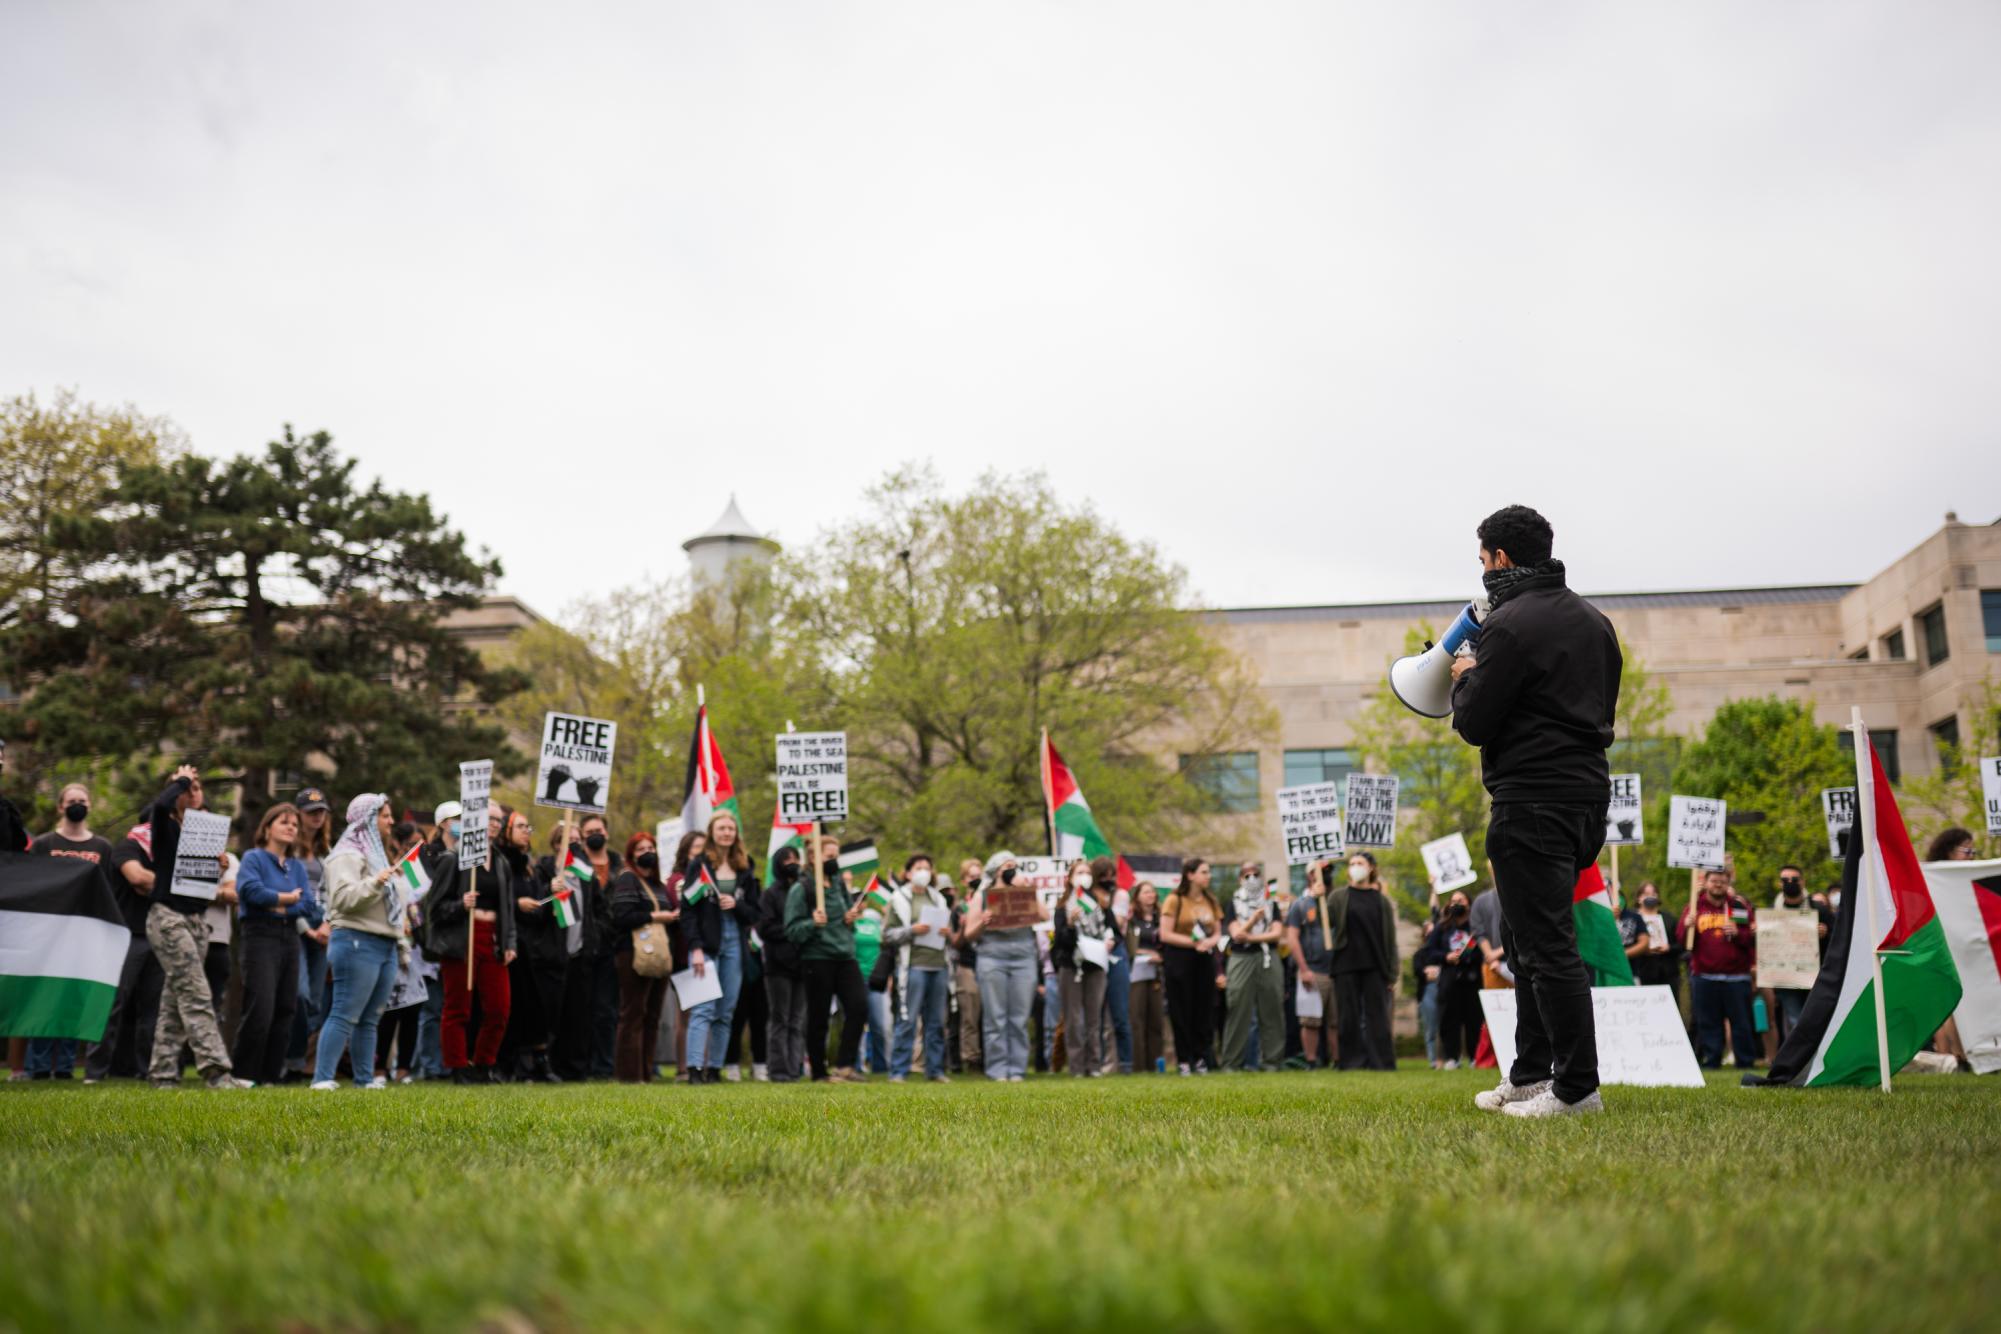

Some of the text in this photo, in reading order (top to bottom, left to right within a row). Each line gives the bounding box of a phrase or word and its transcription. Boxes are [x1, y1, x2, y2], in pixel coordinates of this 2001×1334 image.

[551, 716, 610, 749] FREE
[544, 743, 609, 765] PALESTINE
[789, 747, 844, 758] TO THE SEA
[778, 762, 844, 776] PALESTINE
[782, 780, 819, 790] WILL BE
[1349, 787, 1392, 796] PALESTINE
[782, 790, 844, 813] FREE!
[1348, 797, 1393, 810] END THE
[1282, 808, 1336, 823] PALESTINE
[1346, 821, 1392, 843] NOW!
[1287, 832, 1341, 855] FREE!
